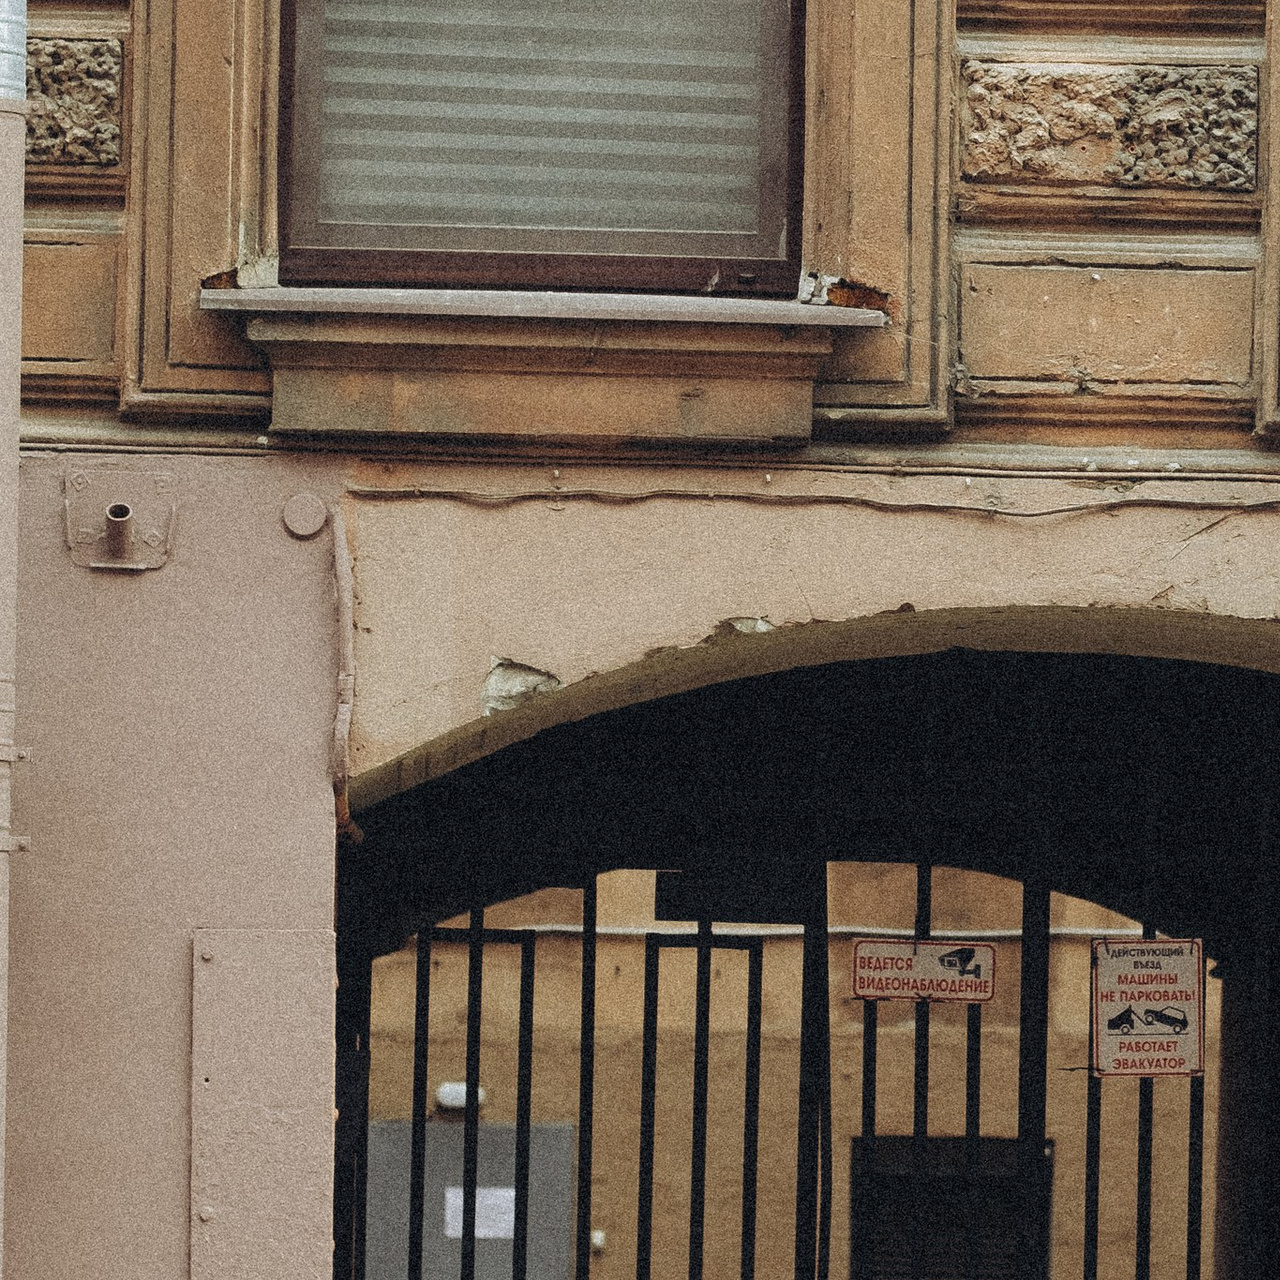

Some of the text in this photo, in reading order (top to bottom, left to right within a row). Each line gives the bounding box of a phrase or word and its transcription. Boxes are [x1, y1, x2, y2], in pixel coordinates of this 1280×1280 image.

[1110, 946, 1184, 959] ДЕЙСТВУЮЩИЙ
[858, 956, 914, 971] ВЕДЕТСЯ
[1133, 960, 1163, 970] ВЪЕЗД
[858, 976, 990, 994] ВИДЕОНАБЛЮДЕНИЕ
[1117, 973, 1179, 986] МАШИНЫ
[1100, 990, 1197, 1003] НЕ ПАРКОВАТЬ!
[1118, 1041, 1179, 1053] РАБОТАЕТ
[1112, 1058, 1186, 1070] ЭВАКУАТОР
